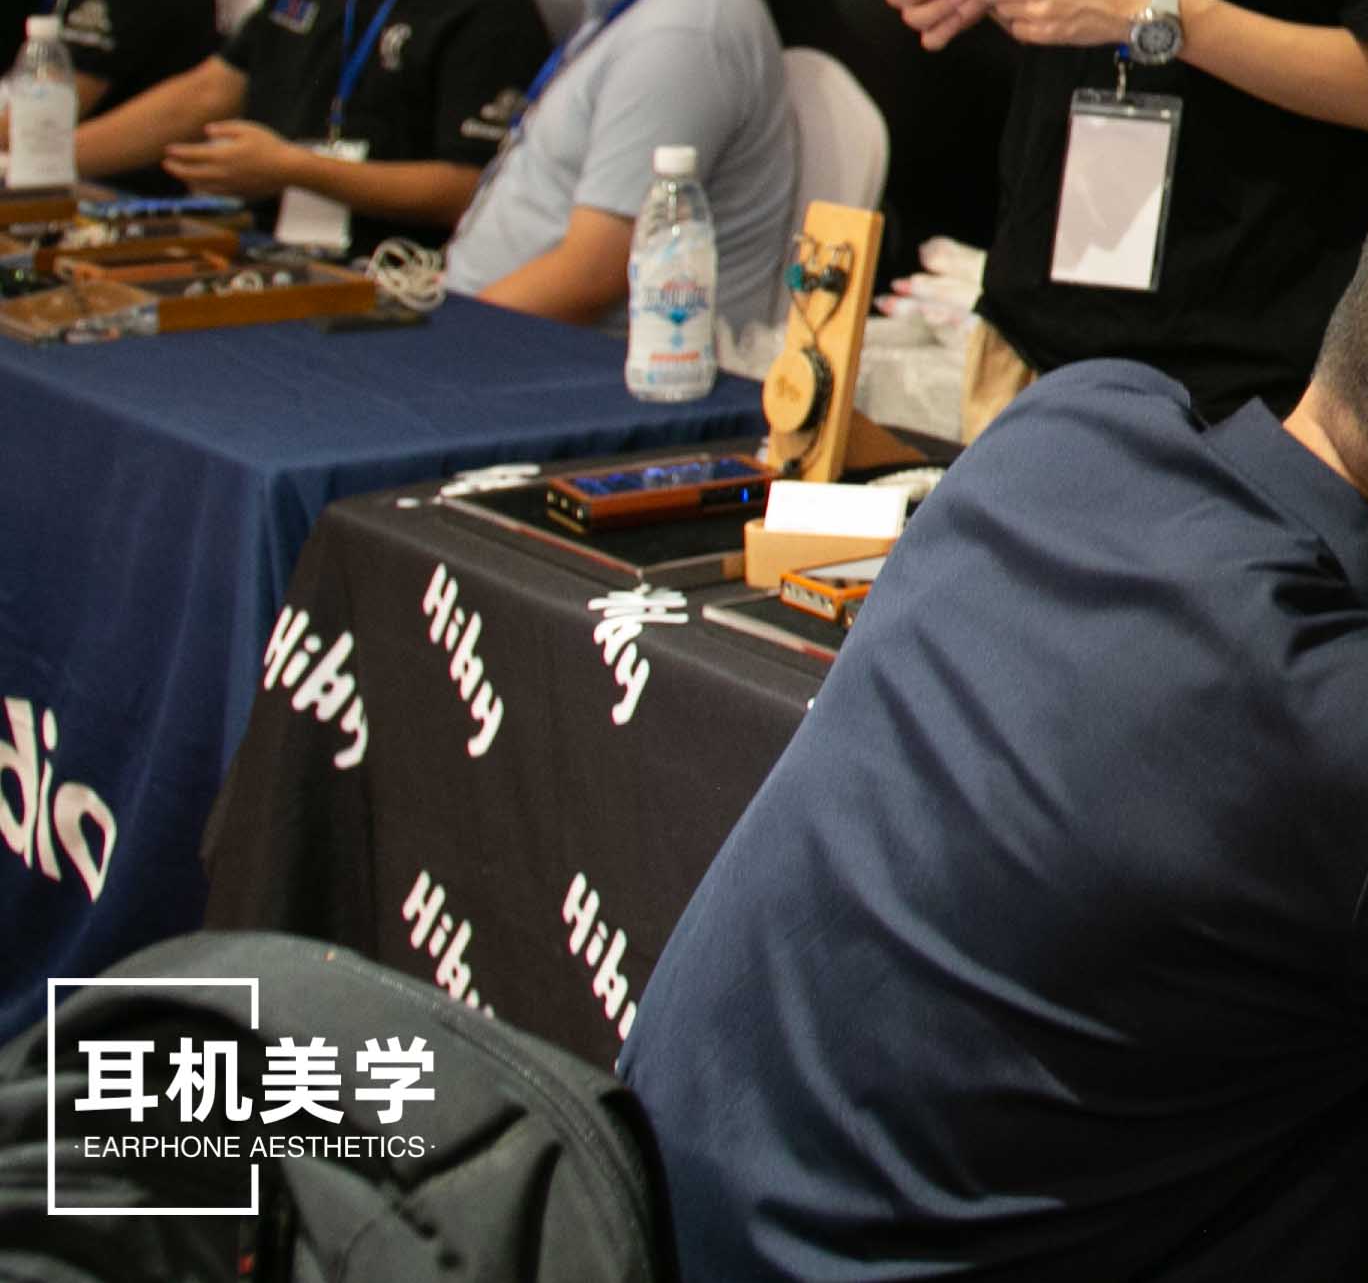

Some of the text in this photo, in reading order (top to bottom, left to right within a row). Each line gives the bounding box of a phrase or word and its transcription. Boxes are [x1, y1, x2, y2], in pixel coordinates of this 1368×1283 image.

[263, 604, 369, 771] Hiby
[422, 562, 504, 758] Hiby
[402, 869, 496, 1020] Hib
